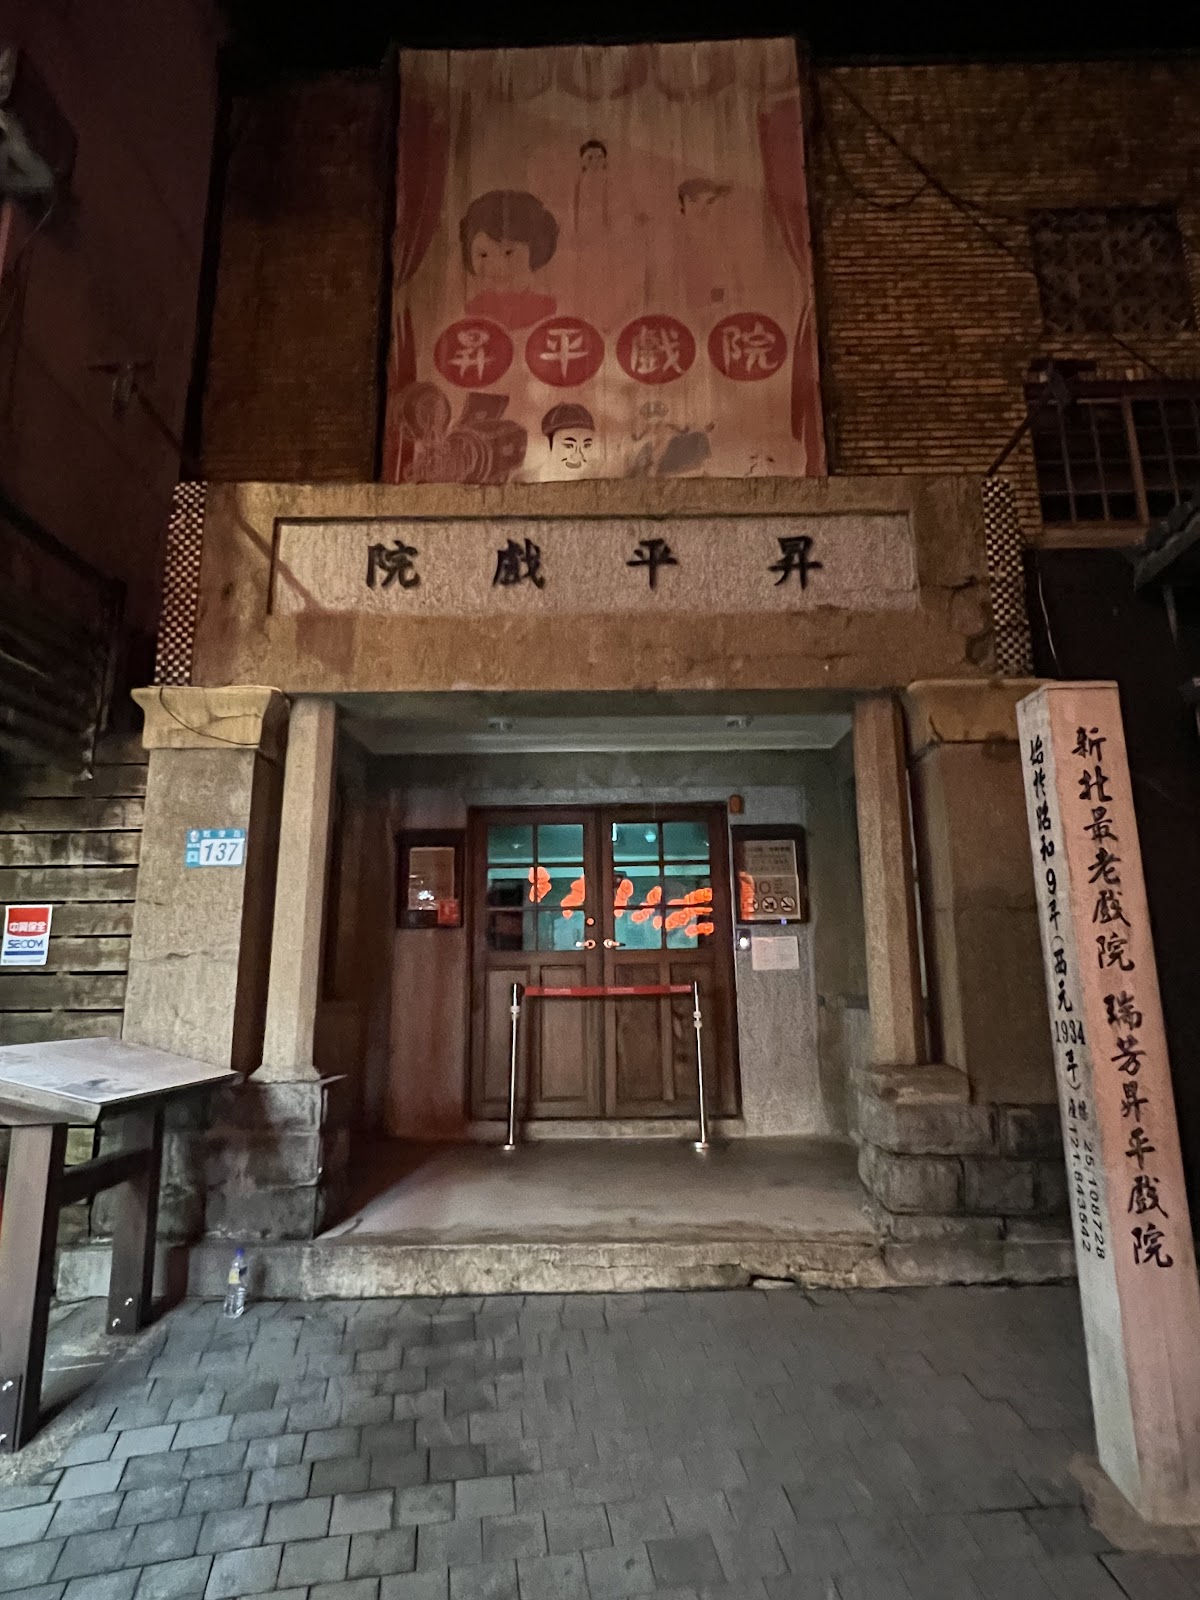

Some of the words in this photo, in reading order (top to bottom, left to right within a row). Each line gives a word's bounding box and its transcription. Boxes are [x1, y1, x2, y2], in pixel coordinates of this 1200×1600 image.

[449, 321, 779, 381] 昇平戲院
[204, 842, 240, 862] 137
[7, 939, 44, 949] SECOM
[1071, 725, 1135, 972] 新北最老戲院
[1103, 990, 1174, 1268] 瑞芳昇平戲院
